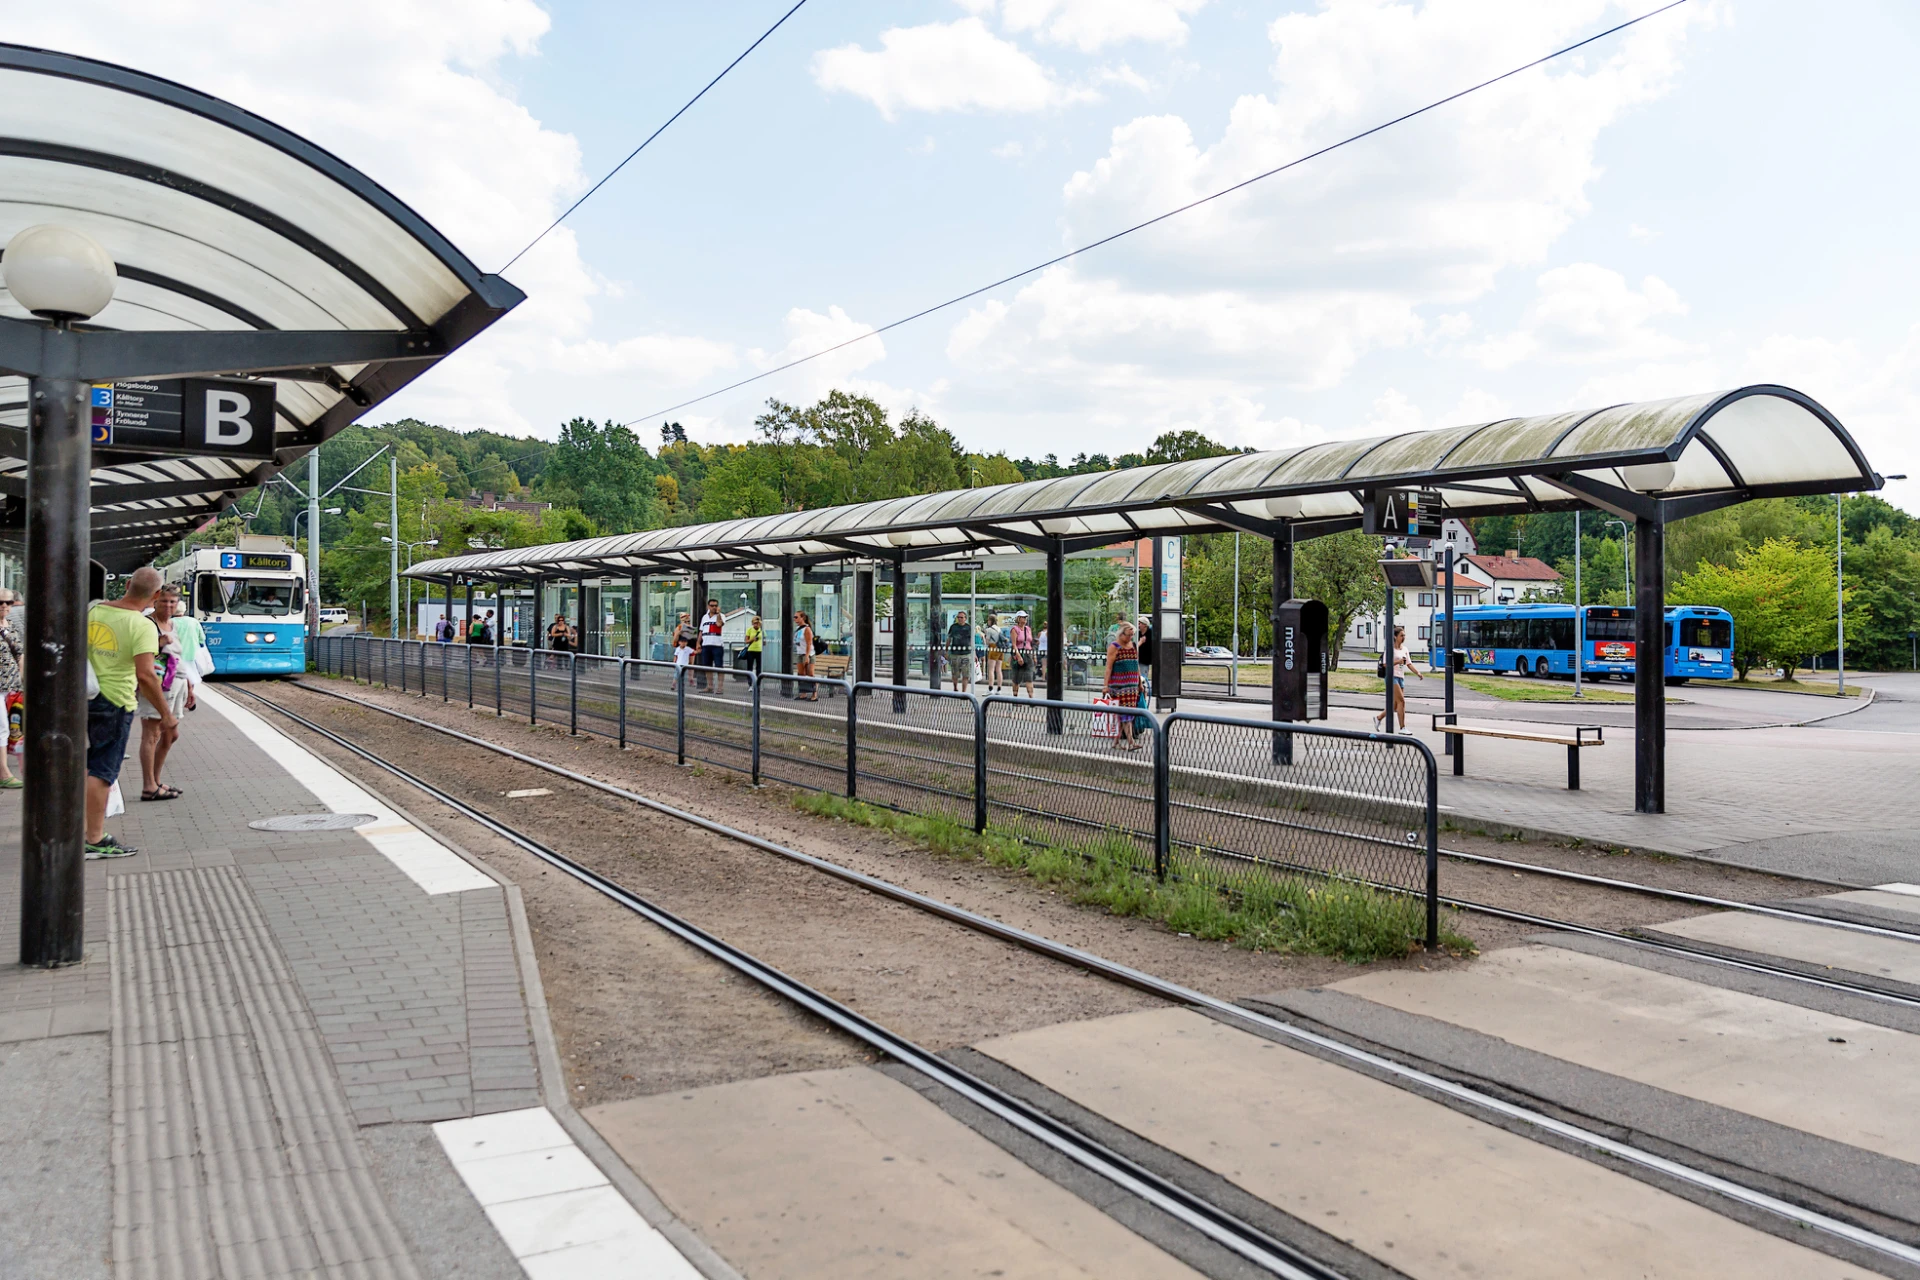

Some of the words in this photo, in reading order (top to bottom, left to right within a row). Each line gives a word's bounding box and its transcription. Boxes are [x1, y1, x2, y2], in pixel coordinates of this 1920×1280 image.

[99, 391, 111, 405] 3
[116, 393, 144, 402] Kålltorp
[115, 417, 147, 426] Frölunda
[116, 410, 149, 419] Tynnered
[204, 389, 253, 446] B
[1383, 495, 1398, 529] A
[1168, 541, 1175, 559] C
[226, 554, 236, 568] 3
[249, 557, 287, 568] Kålltorp
[456, 574, 464, 584] A
[208, 637, 222, 646] 307
[1285, 626, 1295, 670] metro
